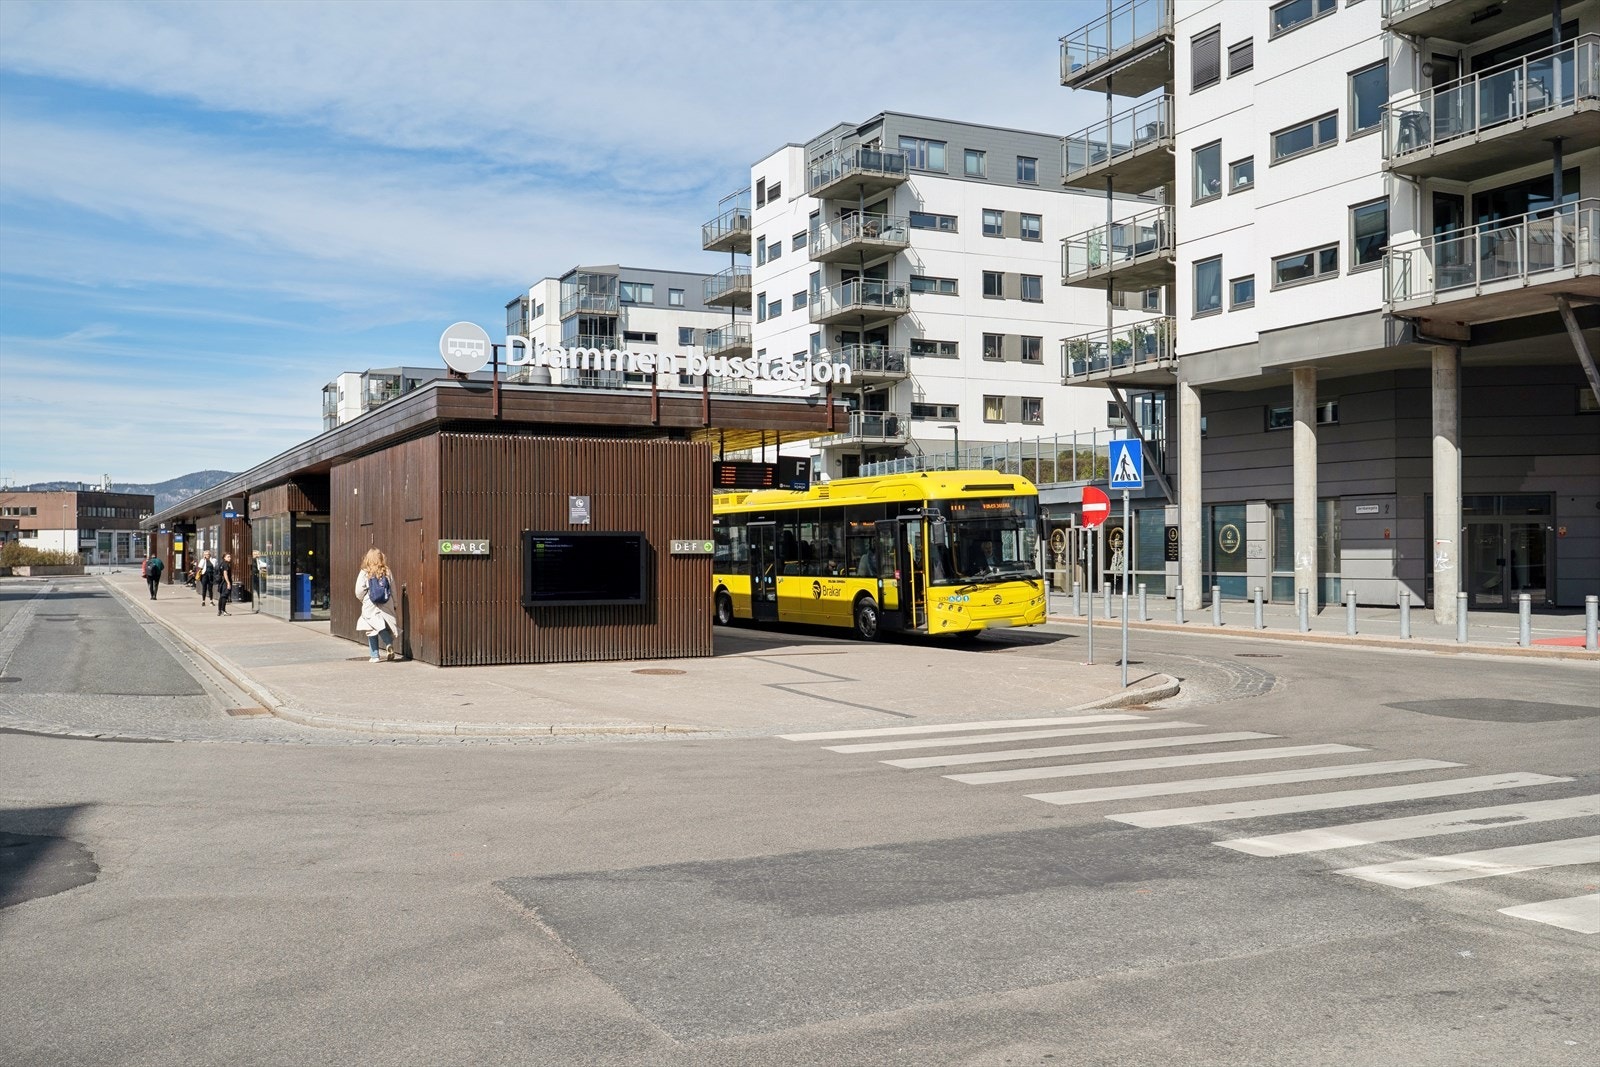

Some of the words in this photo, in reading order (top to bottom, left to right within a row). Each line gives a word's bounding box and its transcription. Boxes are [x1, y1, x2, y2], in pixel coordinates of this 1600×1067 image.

[505, 335, 680, 374] Drammen
[686, 345, 852, 390] busstasjon
[795, 461, 806, 476] F
[225, 500, 234, 510] A
[459, 543, 467, 552] A
[469, 543, 476, 552] B
[478, 543, 486, 552] C
[675, 542, 682, 551] D
[684, 542, 690, 551] E
[822, 585, 842, 597] Brakar
